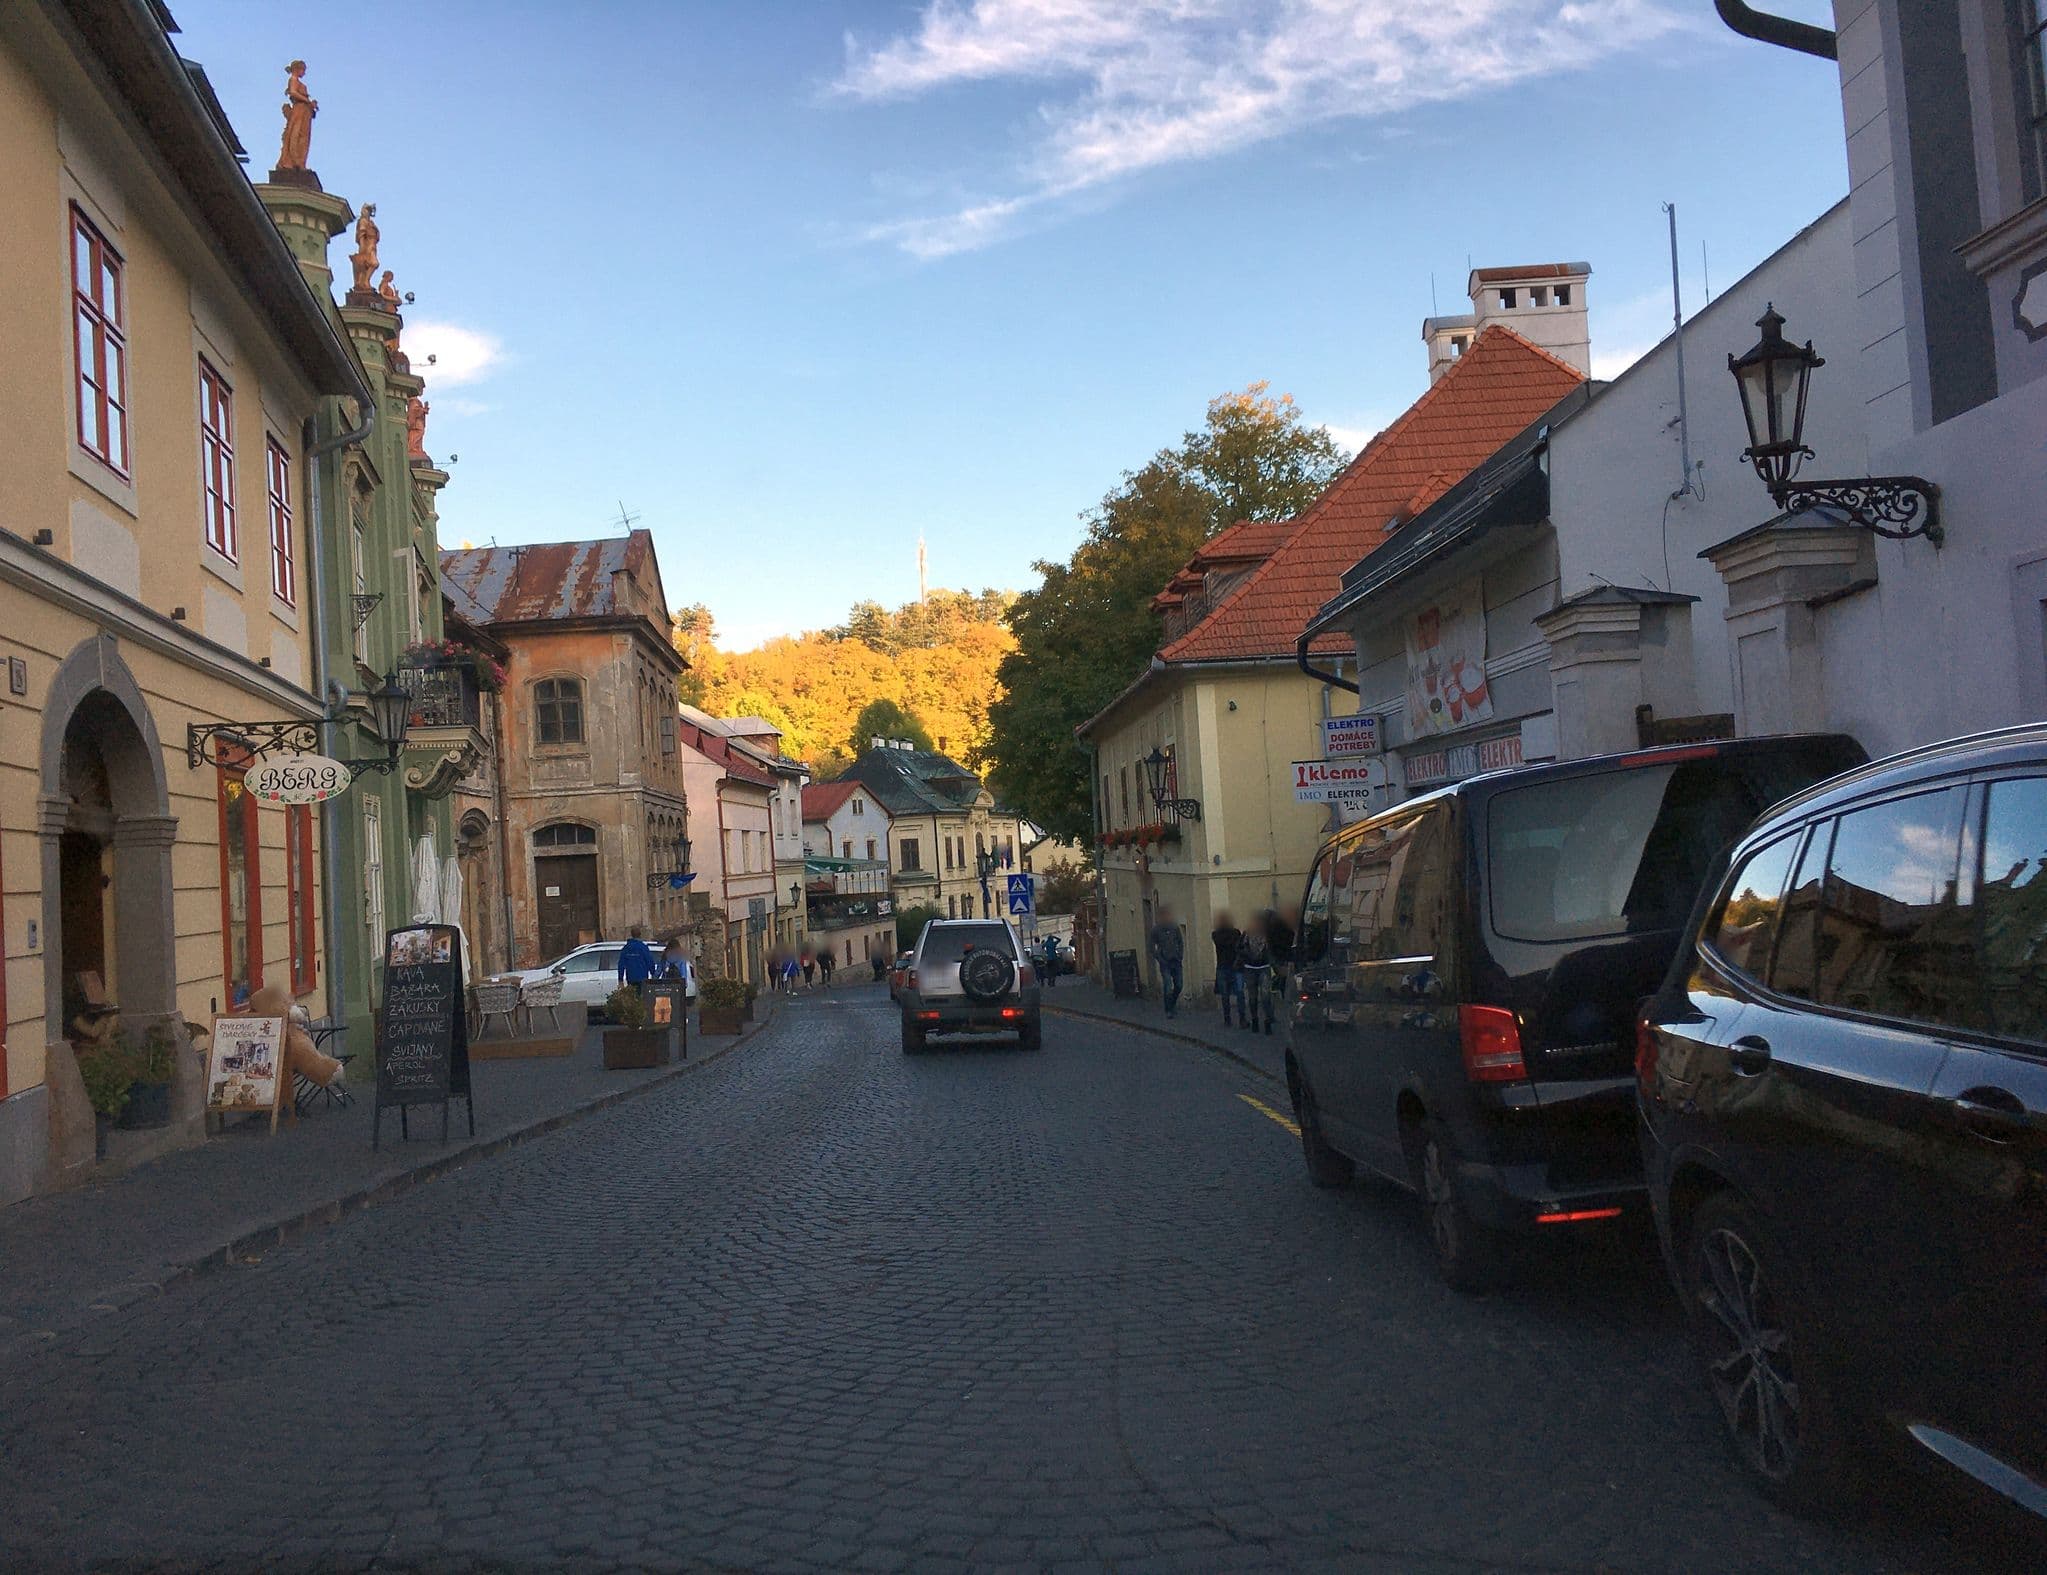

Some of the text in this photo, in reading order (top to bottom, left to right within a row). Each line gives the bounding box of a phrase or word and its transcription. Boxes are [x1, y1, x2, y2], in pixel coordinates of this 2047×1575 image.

[1327, 719, 1375, 730] ELEKTRO
[1328, 741, 1377, 752] POTREBY
[1407, 752, 1446, 782] ELEKTRO
[260, 766, 338, 791] BERG
[1298, 789, 1370, 800] IMO ELEKTRO
